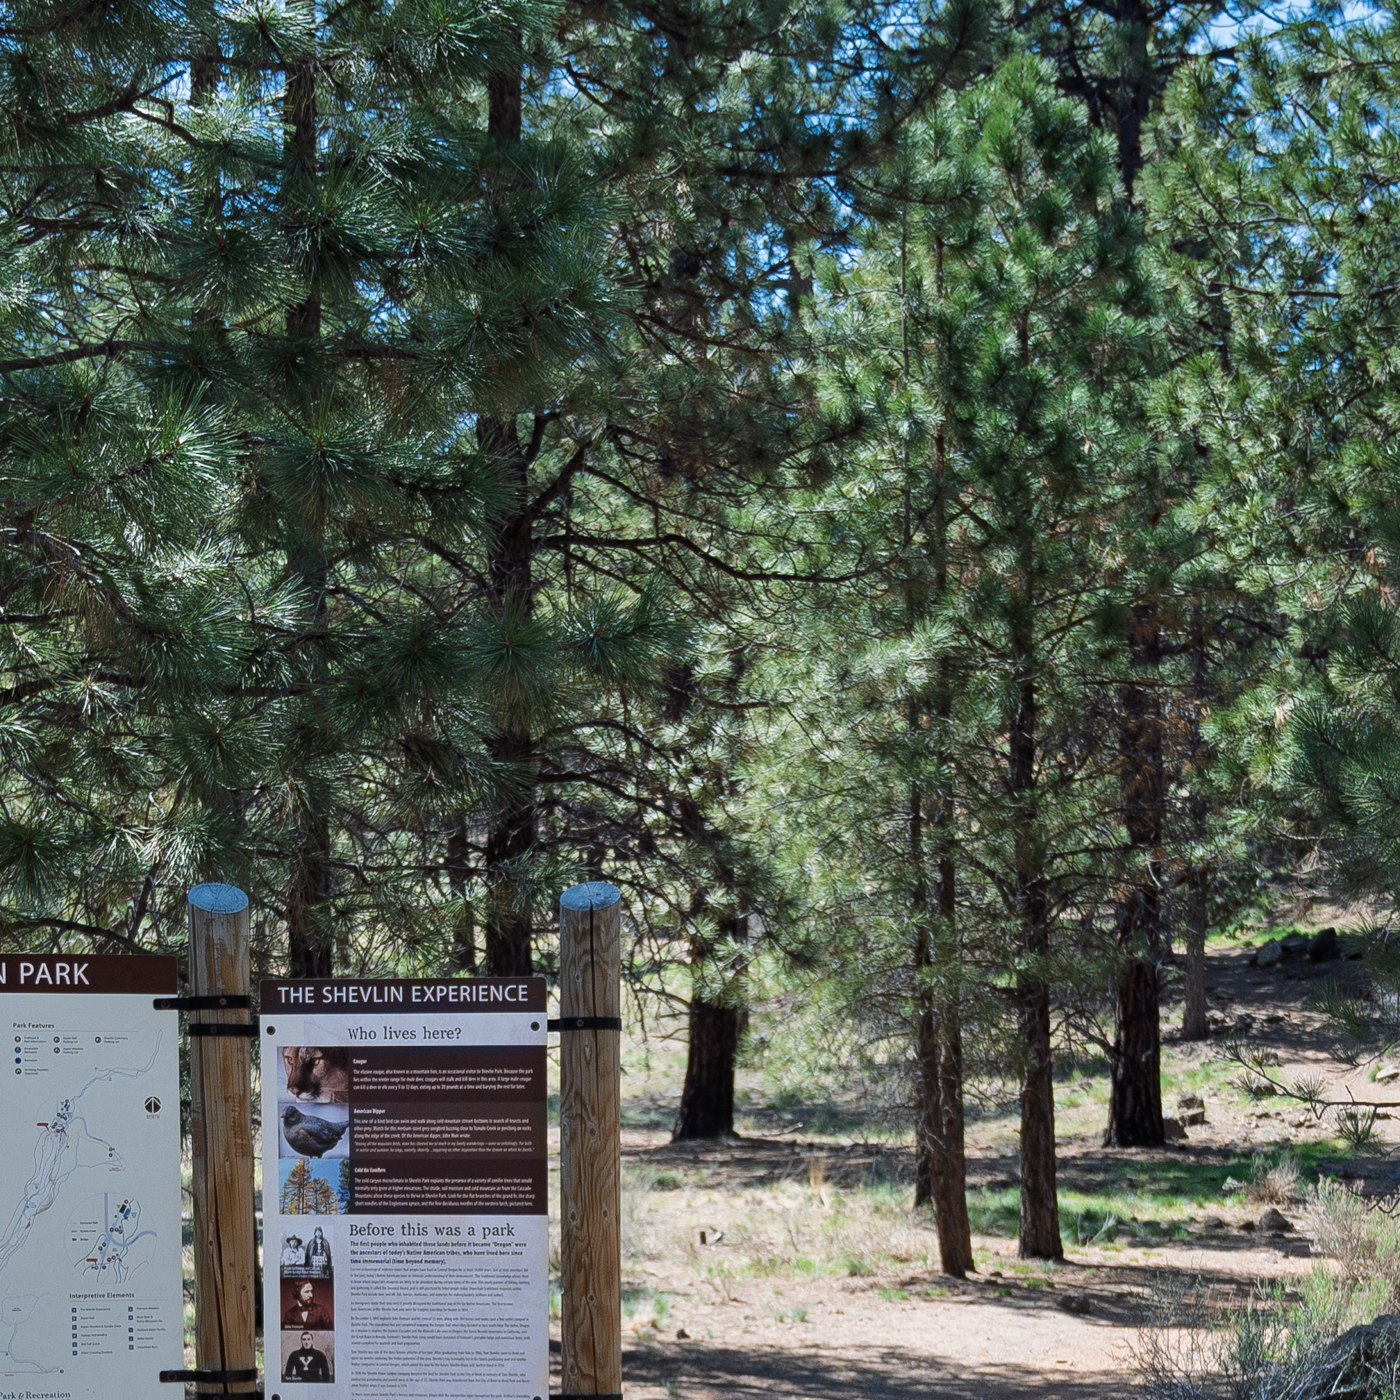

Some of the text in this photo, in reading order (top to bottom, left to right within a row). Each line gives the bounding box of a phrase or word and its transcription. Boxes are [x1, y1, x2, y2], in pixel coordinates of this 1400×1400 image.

[20, 962, 90, 984] PARK
[278, 985, 528, 1003] THE SHEVLIN EXPERIENCE
[348, 1026, 462, 1039] Who lives here?
[349, 1224, 515, 1239] Before this was a park
[300, 1357, 313, 1370] Y
[26, 1391, 71, 1399] Recreation
